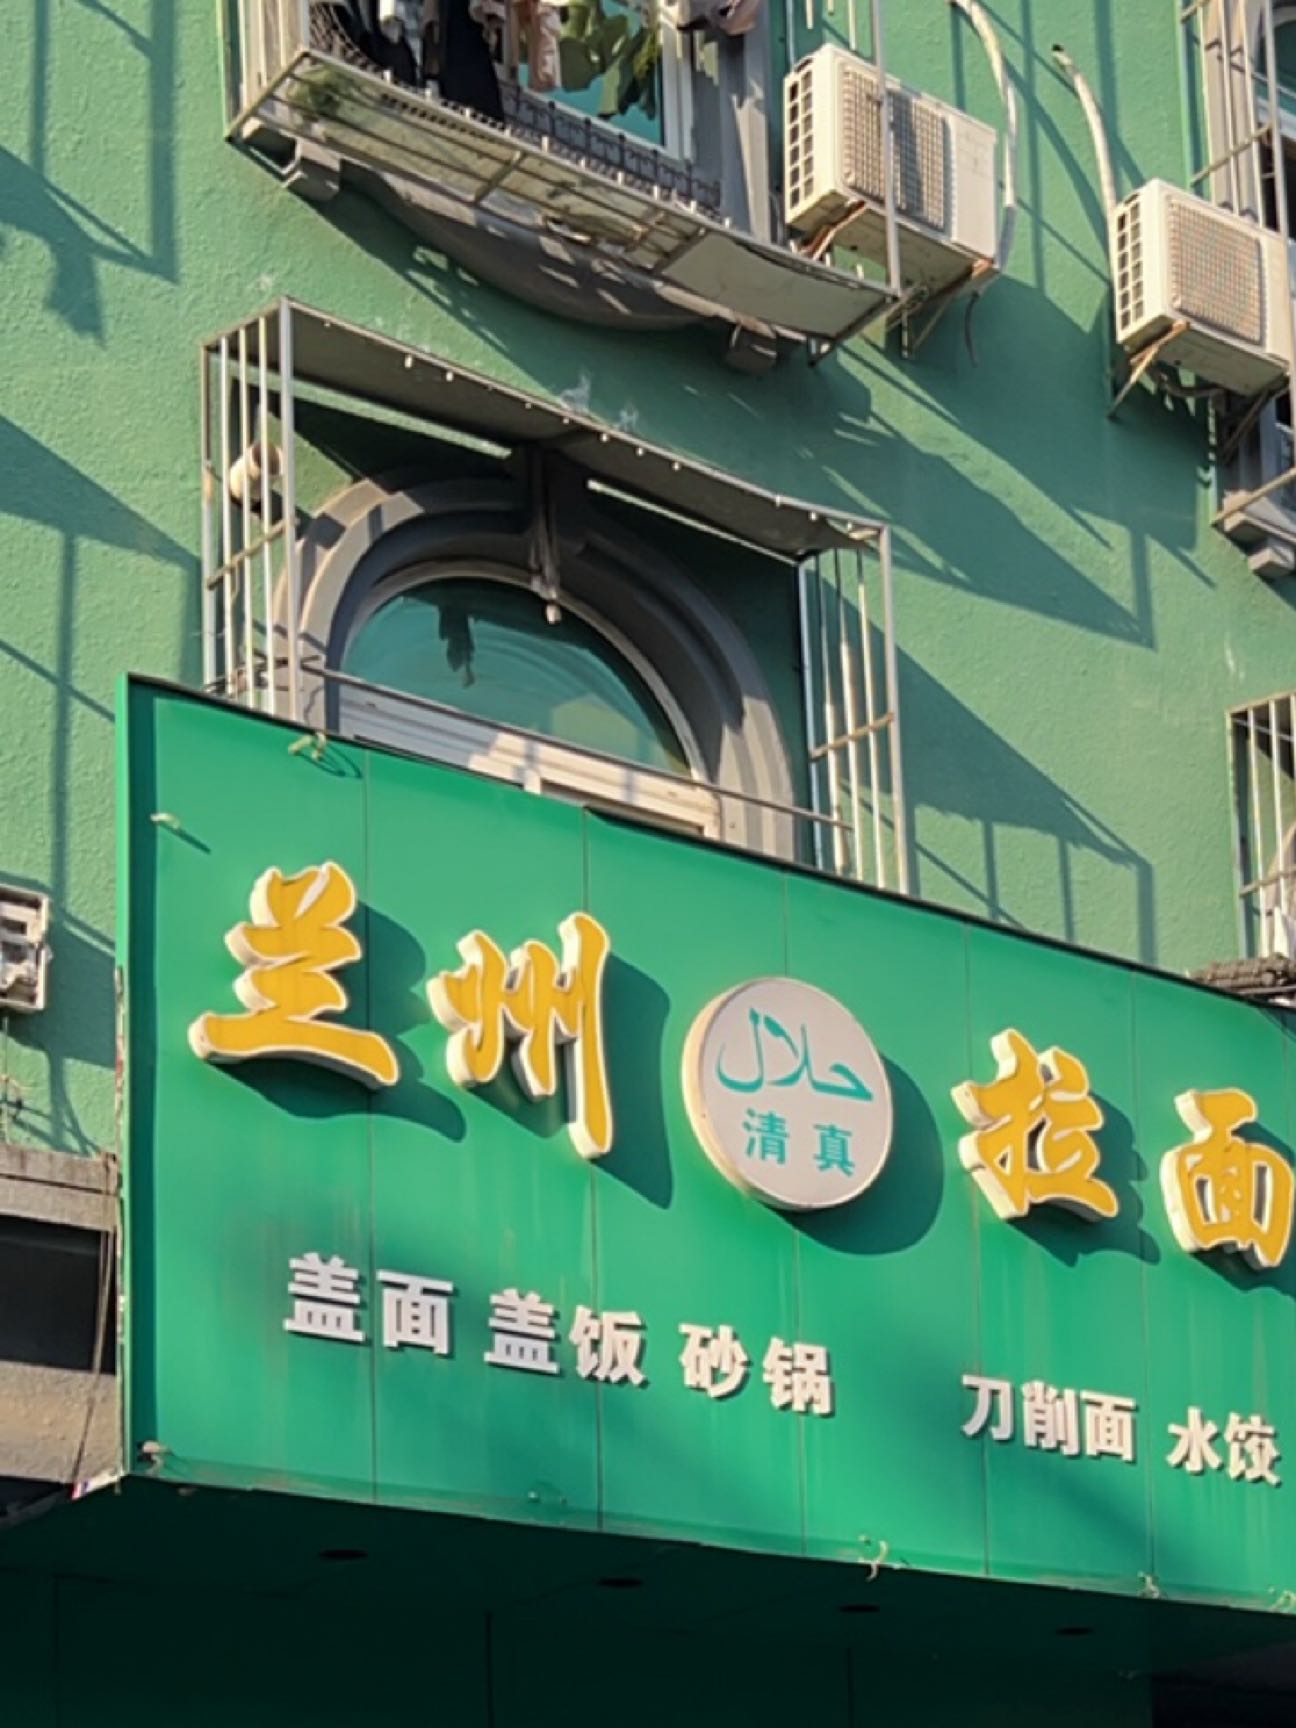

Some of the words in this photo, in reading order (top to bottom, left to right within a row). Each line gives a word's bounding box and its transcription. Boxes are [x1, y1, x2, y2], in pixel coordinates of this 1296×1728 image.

[188, 861, 609, 1158] 兰州
[951, 1028, 1296, 1268] 拉面
[741, 1107, 856, 1178] 清真
[283, 1252, 454, 1355] 盖面
[484, 1288, 647, 1386] 盖饭
[678, 1322, 834, 1415] 砂锅
[961, 1374, 1136, 1462] 刀削面
[1166, 1406, 1281, 1487] 水饺
